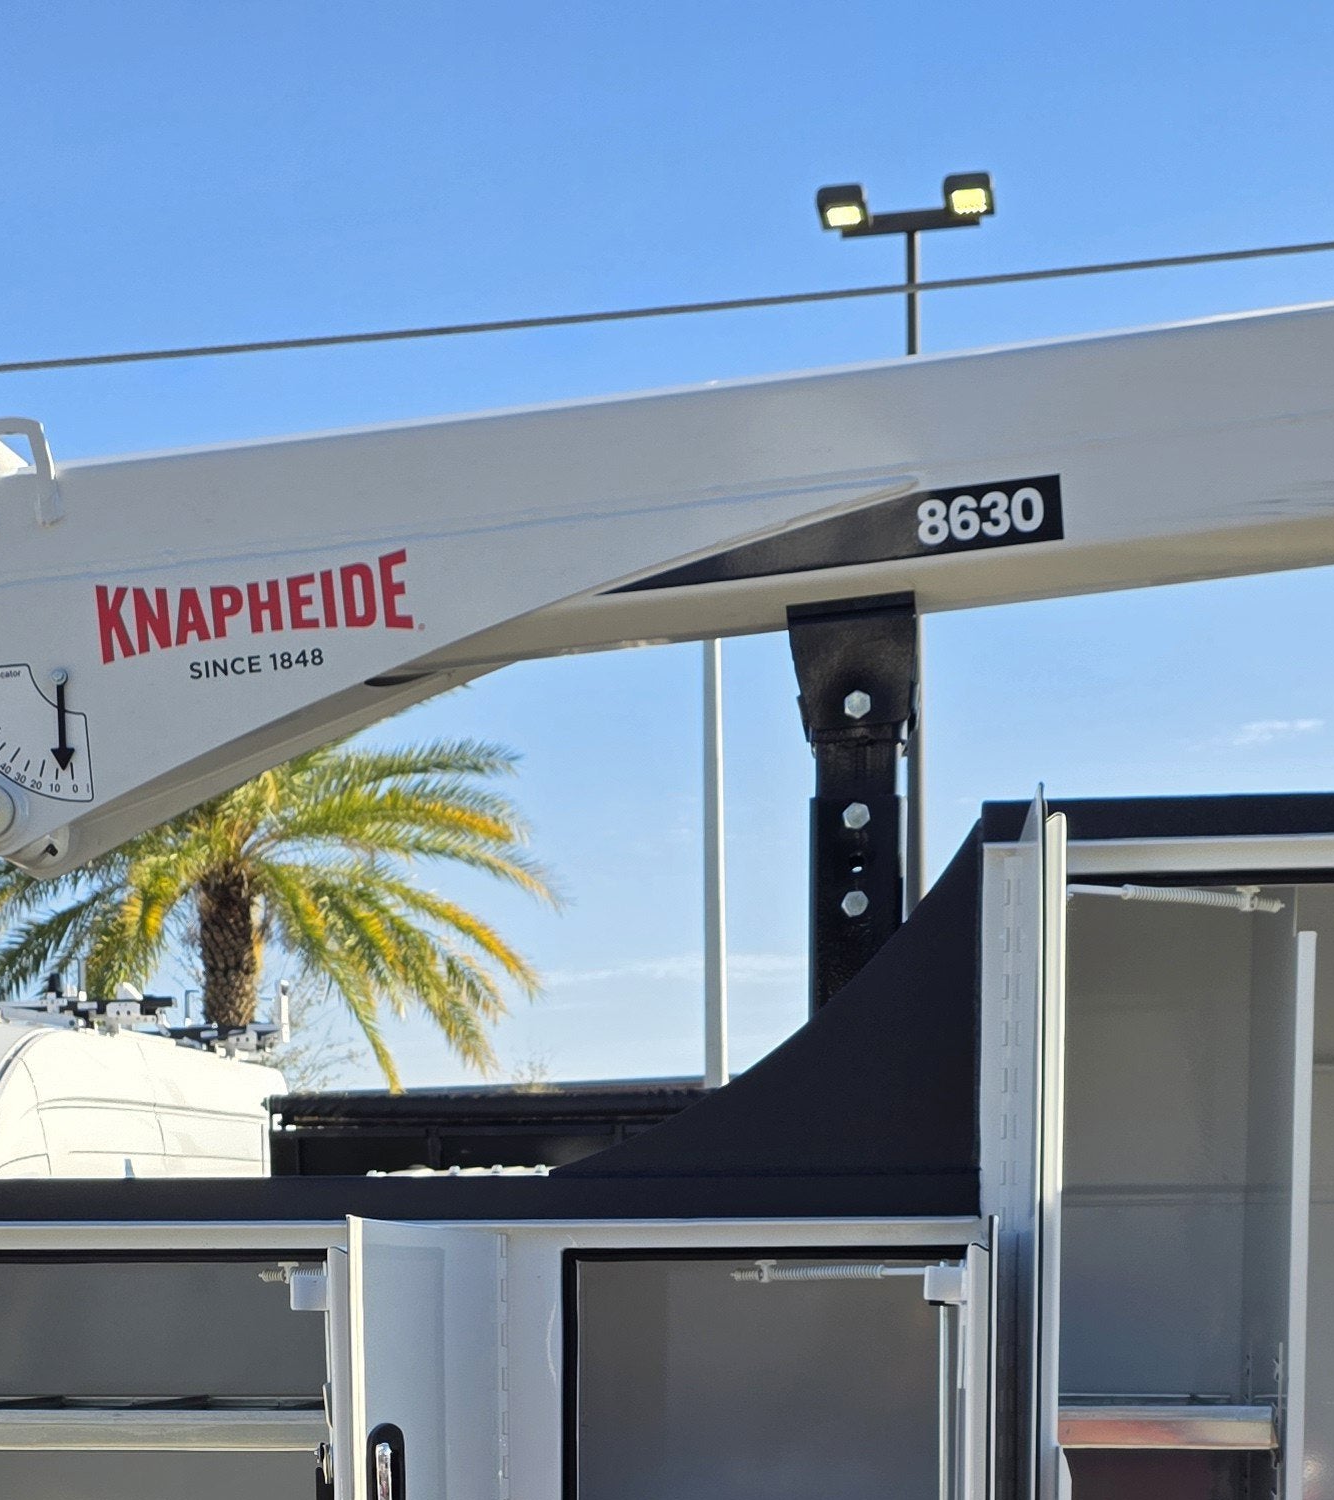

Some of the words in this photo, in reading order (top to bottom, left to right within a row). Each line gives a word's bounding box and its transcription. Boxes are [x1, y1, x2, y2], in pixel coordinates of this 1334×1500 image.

[917, 486, 1044, 546] 8630
[95, 548, 415, 665] KNAPHEIDE
[189, 654, 263, 680] SINCE
[270, 647, 325, 671] 1848
[0, 763, 12, 774] 40
[14, 773, 27, 784] 30
[30, 780, 43, 790] 20
[49, 784, 61, 793] 10
[72, 784, 79, 793] 0
